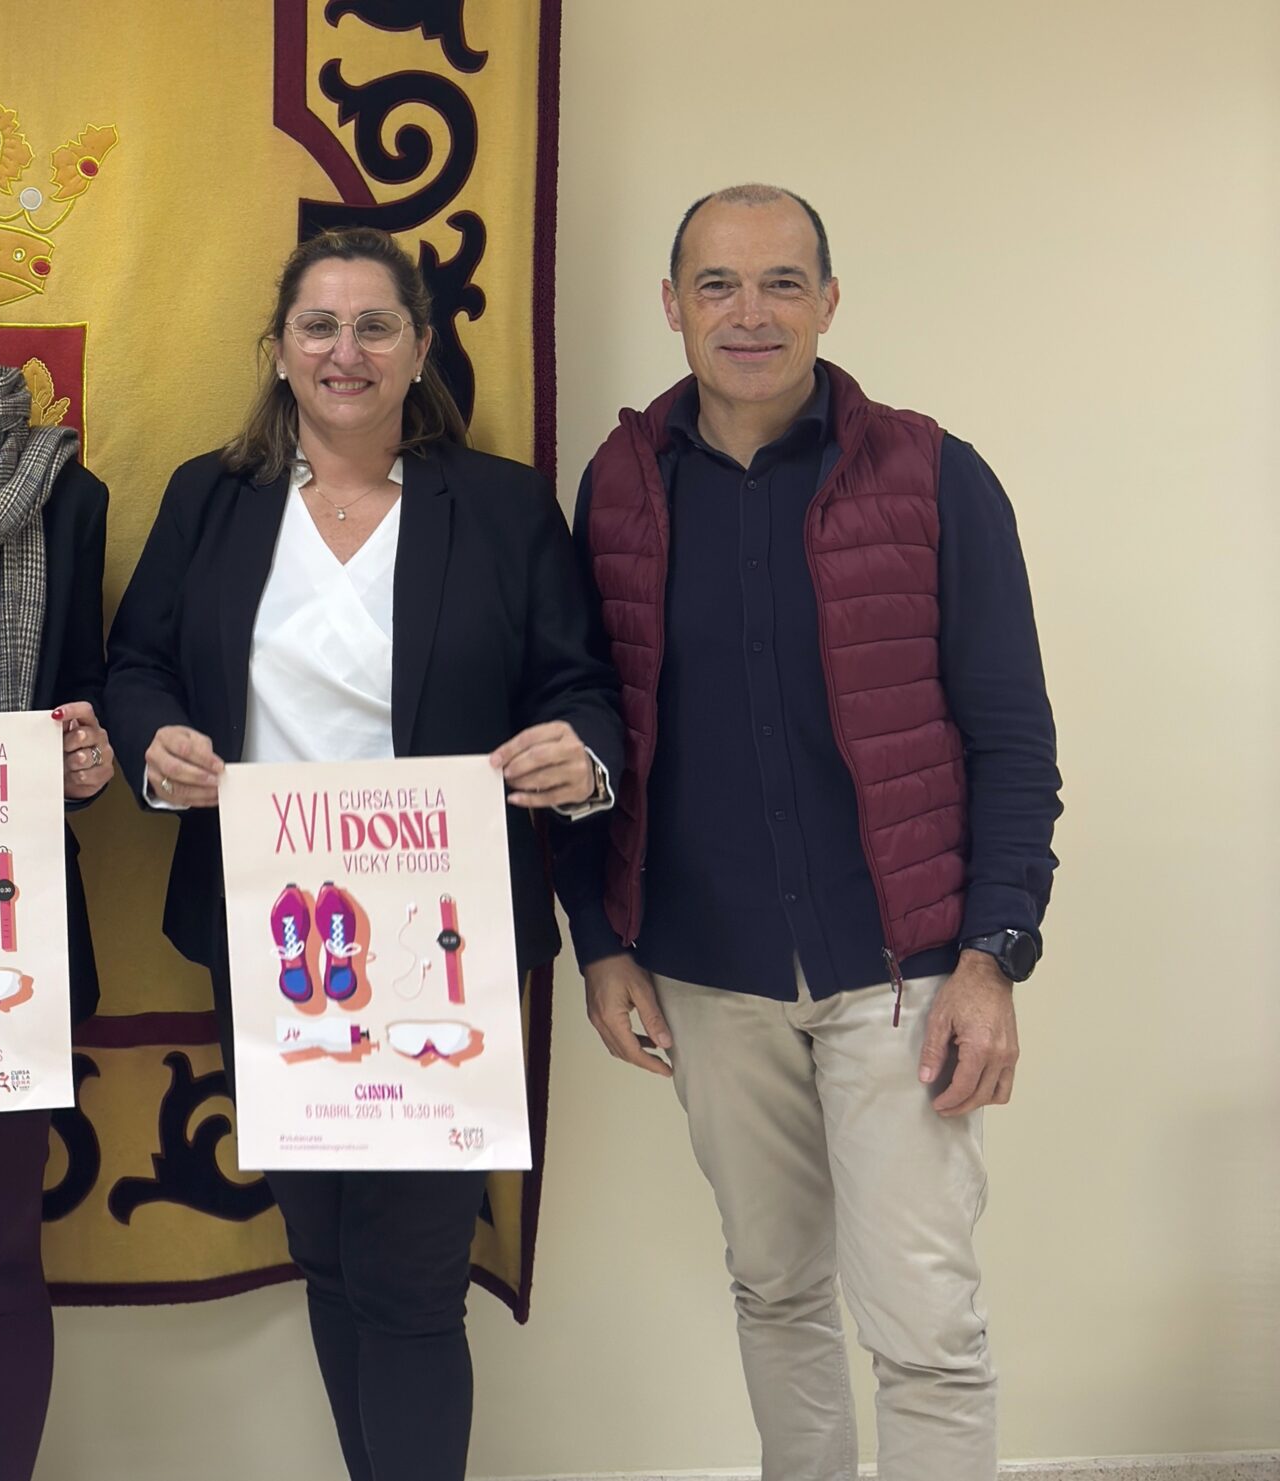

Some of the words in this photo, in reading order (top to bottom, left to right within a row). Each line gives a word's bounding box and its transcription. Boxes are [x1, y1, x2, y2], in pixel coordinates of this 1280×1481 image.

[339, 789, 394, 811] CURSA
[397, 788, 418, 808] DE
[425, 788, 446, 808] LA
[271, 791, 332, 854] XVI
[340, 810, 449, 852] DONA
[343, 853, 390, 874] VICKY
[396, 852, 451, 873] FOODS
[354, 1084, 404, 1101] GANDIA
[305, 1106, 312, 1119] 6
[315, 1104, 353, 1119] D'ABRIL
[355, 1104, 382, 1119] 2025
[403, 1104, 430, 1119] 10:30
[433, 1103, 455, 1119] HRS
